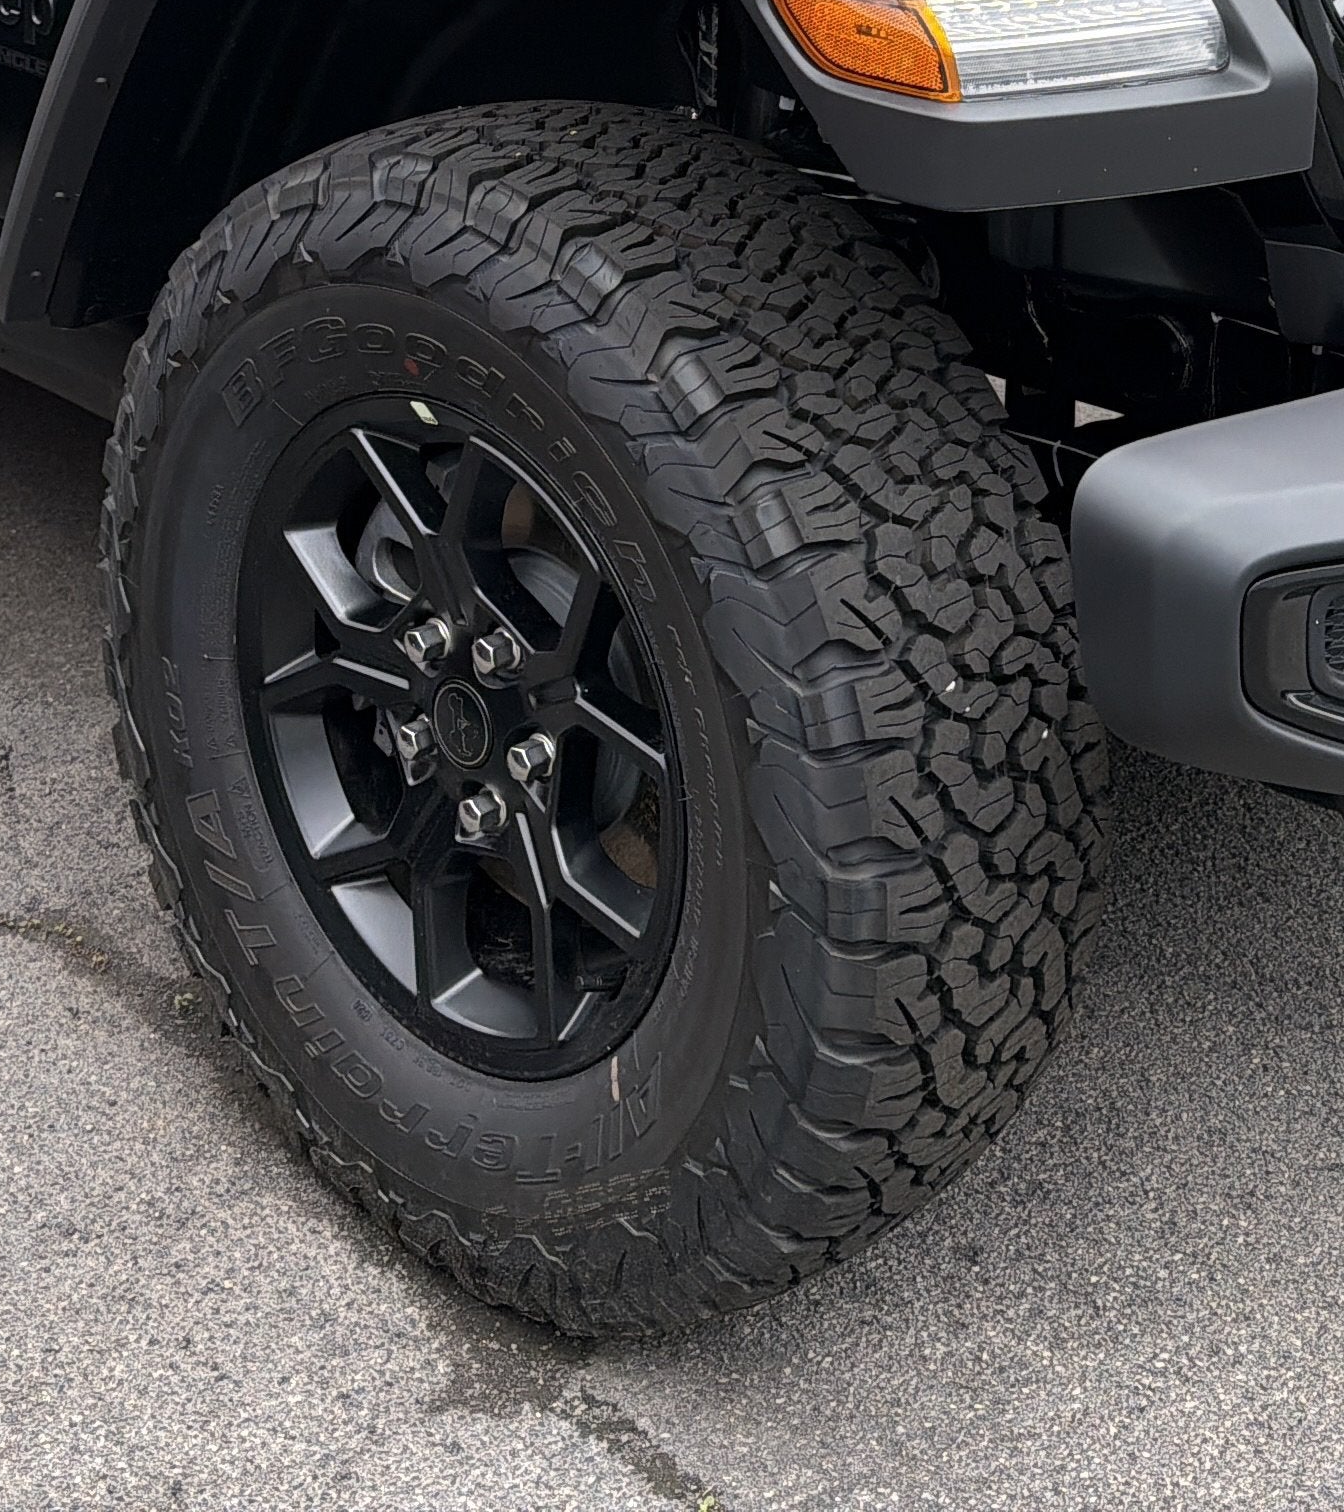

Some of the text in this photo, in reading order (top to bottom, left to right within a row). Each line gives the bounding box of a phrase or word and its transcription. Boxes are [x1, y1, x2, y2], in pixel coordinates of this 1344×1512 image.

[220, 315, 658, 602] BFGoodrich
[186, 791, 277, 969] T/A
[273, 974, 664, 1185] All-Terrain
